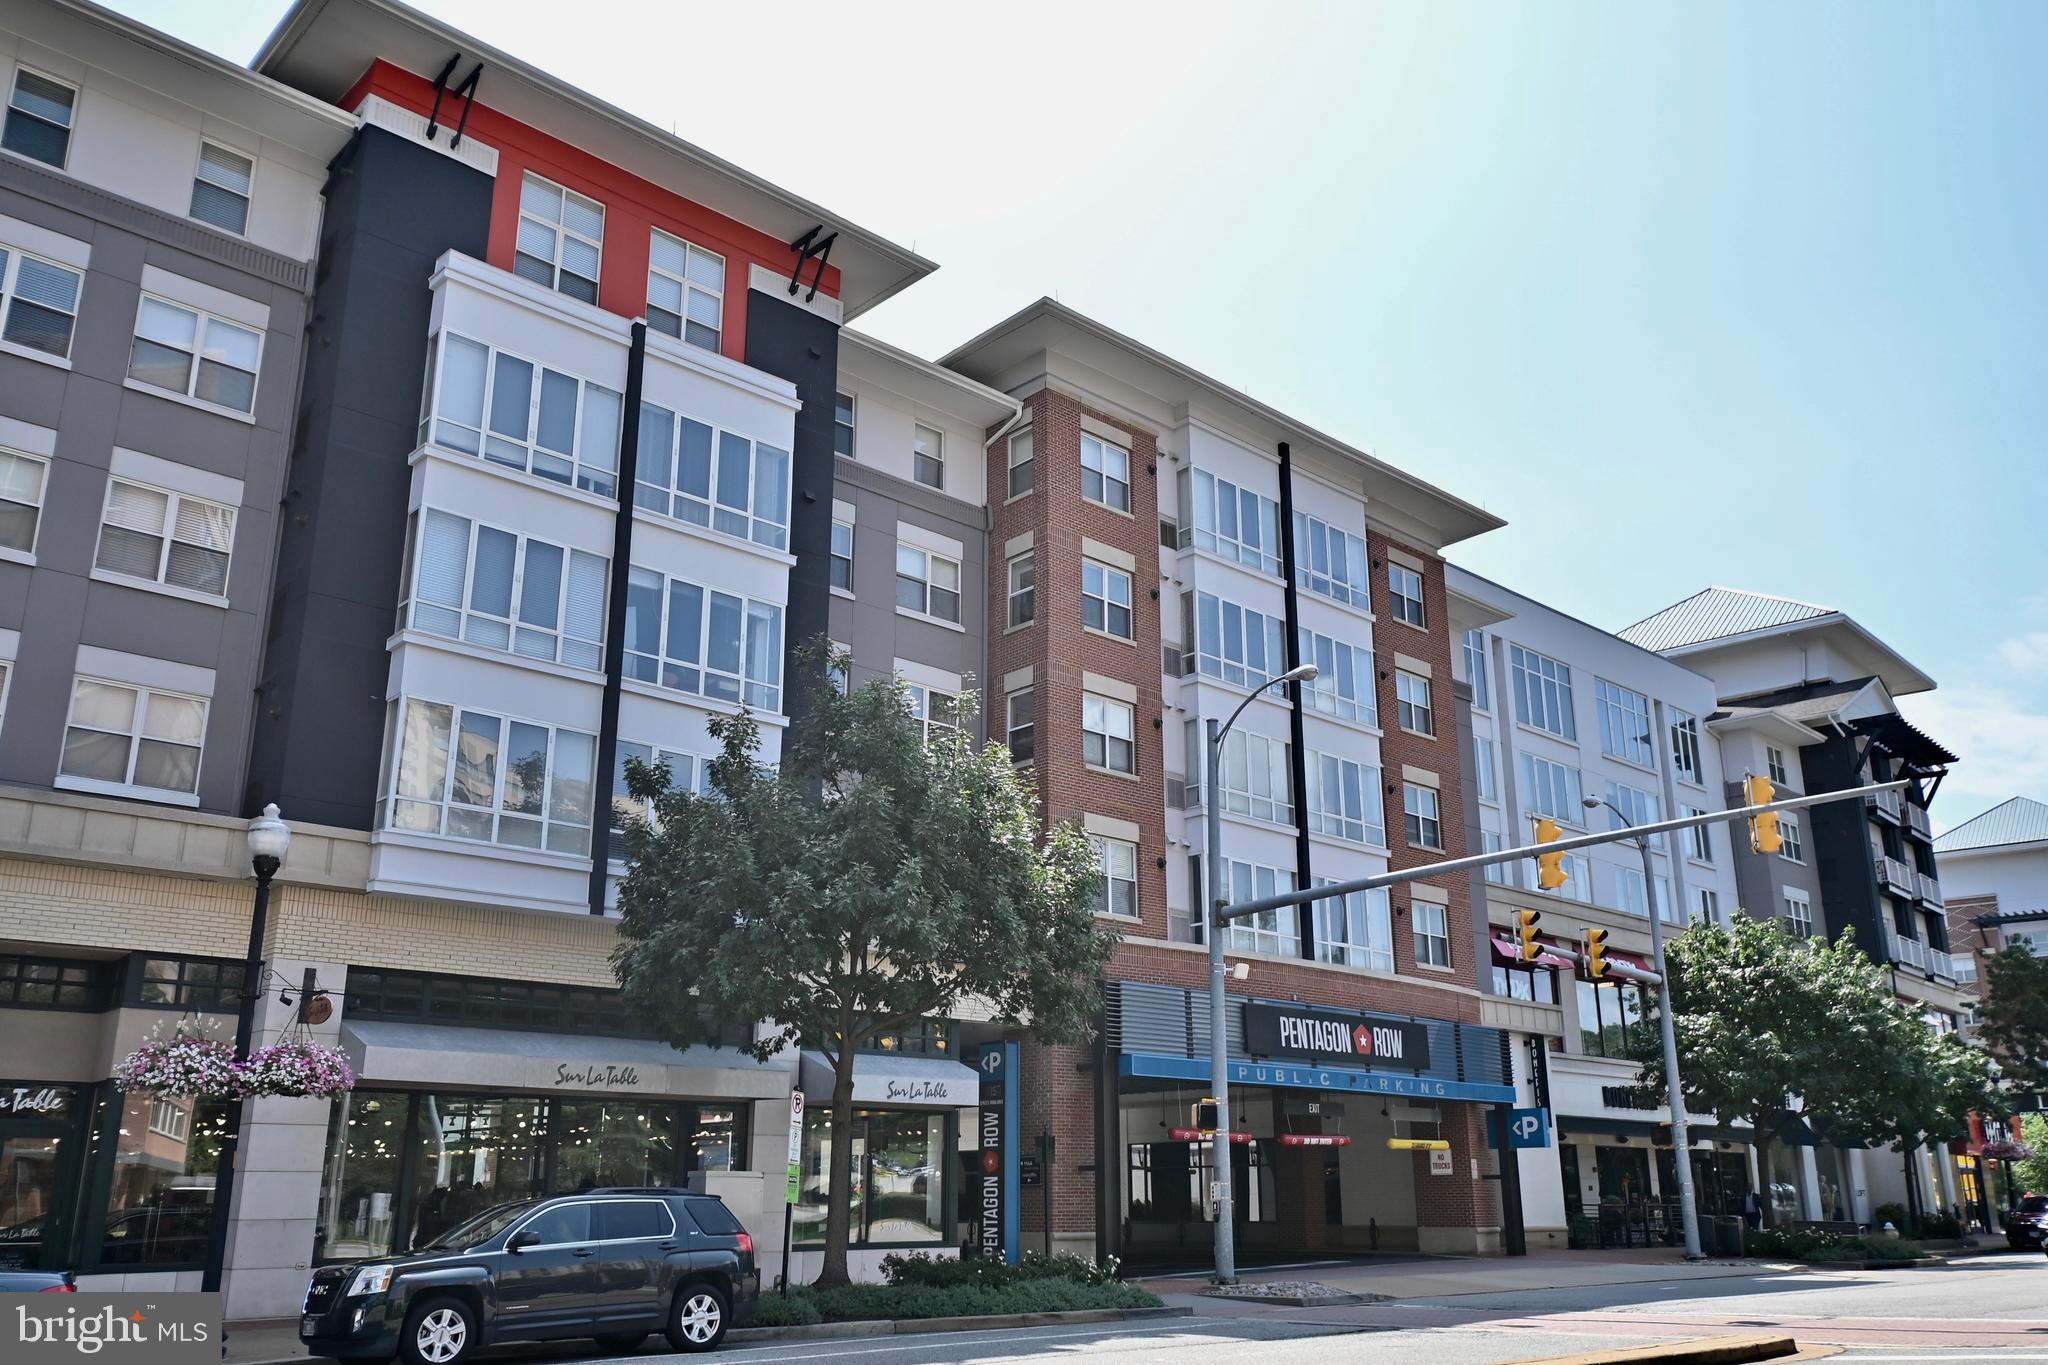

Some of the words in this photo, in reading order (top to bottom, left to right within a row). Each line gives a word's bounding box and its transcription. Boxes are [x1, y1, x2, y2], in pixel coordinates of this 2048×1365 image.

[1279, 1016, 1352, 1053] PENTAGON
[1373, 1026, 1403, 1059] ROW
[990, 1051, 1001, 1073] P
[555, 1063, 586, 1086] Sur
[586, 1065, 606, 1086] La
[606, 1065, 640, 1088] Table
[1238, 1067, 1331, 1085] PUBLIC
[1350, 1075, 1446, 1095] PARKING
[12, 1088, 63, 1113] Table
[886, 1080, 908, 1099] Sur
[909, 1081, 923, 1099] La
[923, 1081, 948, 1100] Table
[1308, 1103, 1320, 1114] EXIT
[983, 1112, 999, 1148] ROW
[1521, 1116, 1539, 1140] P
[1432, 1162, 1451, 1170] TRUCKS
[1437, 1153, 1445, 1161] NO
[983, 1176, 999, 1257] PENTAGON
